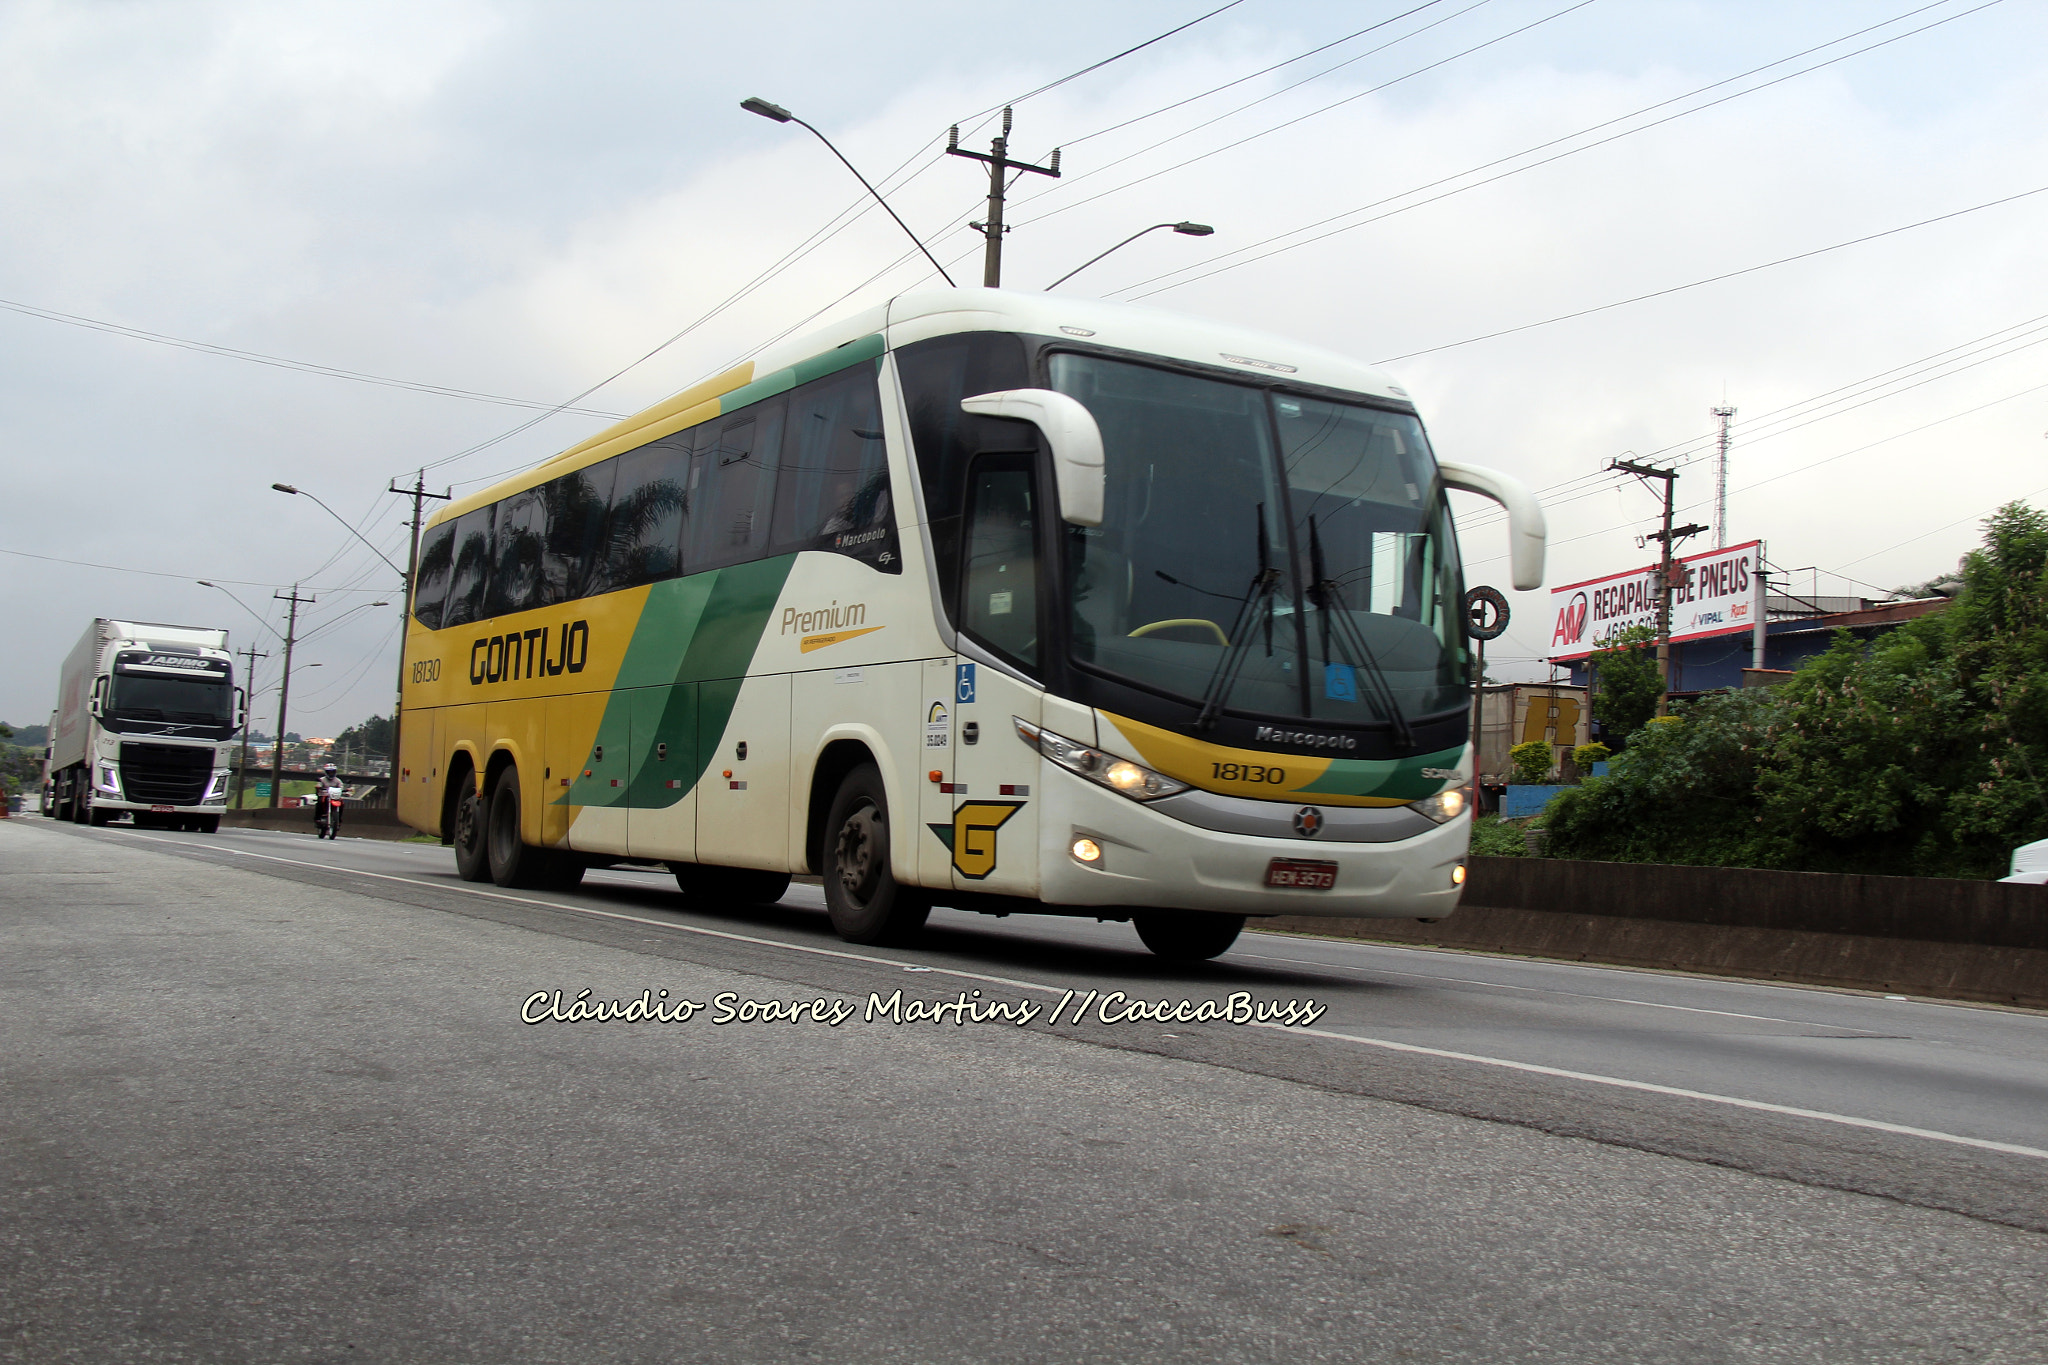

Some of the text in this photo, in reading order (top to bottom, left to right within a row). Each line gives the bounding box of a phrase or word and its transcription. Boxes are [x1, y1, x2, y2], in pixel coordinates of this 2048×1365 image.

[841, 528, 886, 548] Marcopolo
[1593, 578, 1661, 621] RECAPA
[1699, 556, 1749, 600] PNEUS
[781, 600, 866, 636] Premium
[1698, 611, 1724, 625] VIPAL
[141, 655, 211, 668] JADIMO
[470, 619, 590, 686] GONTIJO
[412, 658, 442, 685] 18130
[1255, 726, 1357, 750] Marcopolo
[1211, 762, 1285, 785] 18130
[1421, 767, 1463, 781] SCANIA
